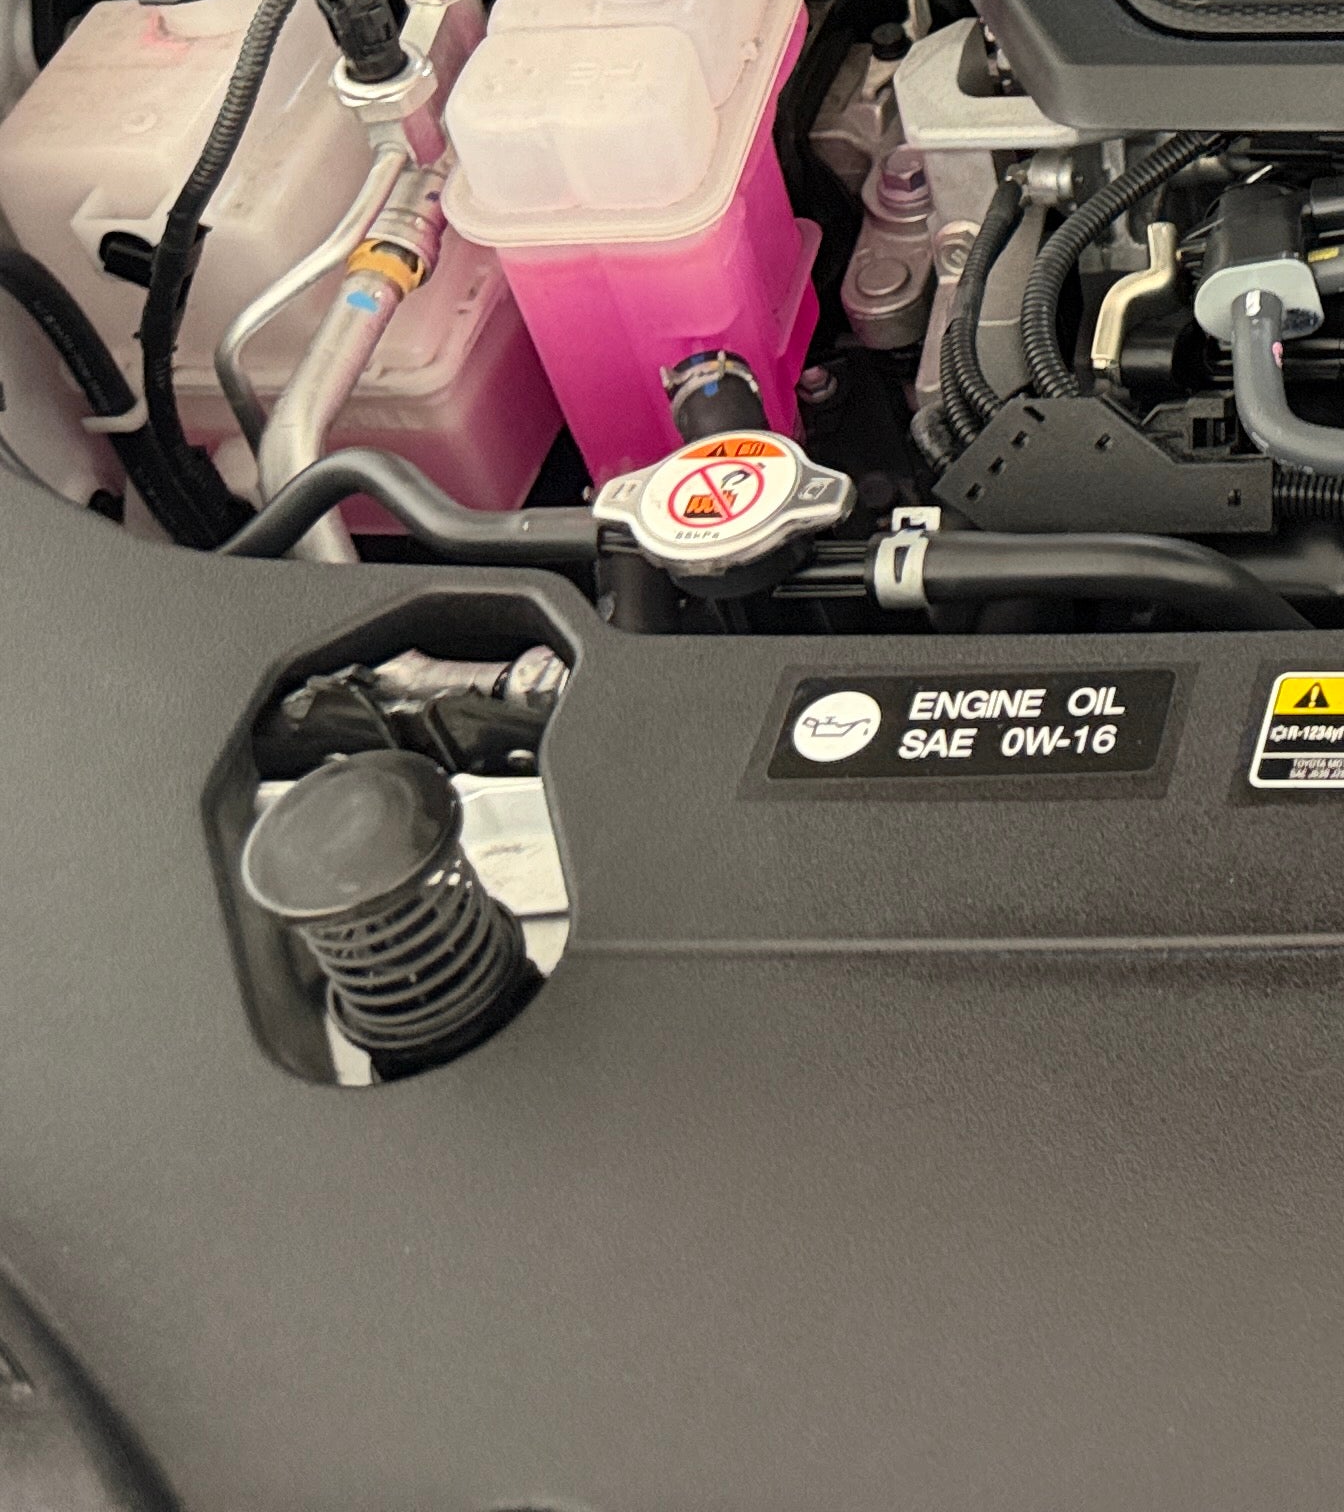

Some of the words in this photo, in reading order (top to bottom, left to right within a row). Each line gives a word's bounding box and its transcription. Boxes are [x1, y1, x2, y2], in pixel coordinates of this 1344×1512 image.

[908, 688, 1047, 721] ENGINE
[1066, 686, 1126, 717] OIL
[898, 727, 978, 760] SAE
[1001, 724, 1118, 758] 0W-16
[1293, 758, 1327, 768] TOYOTA
